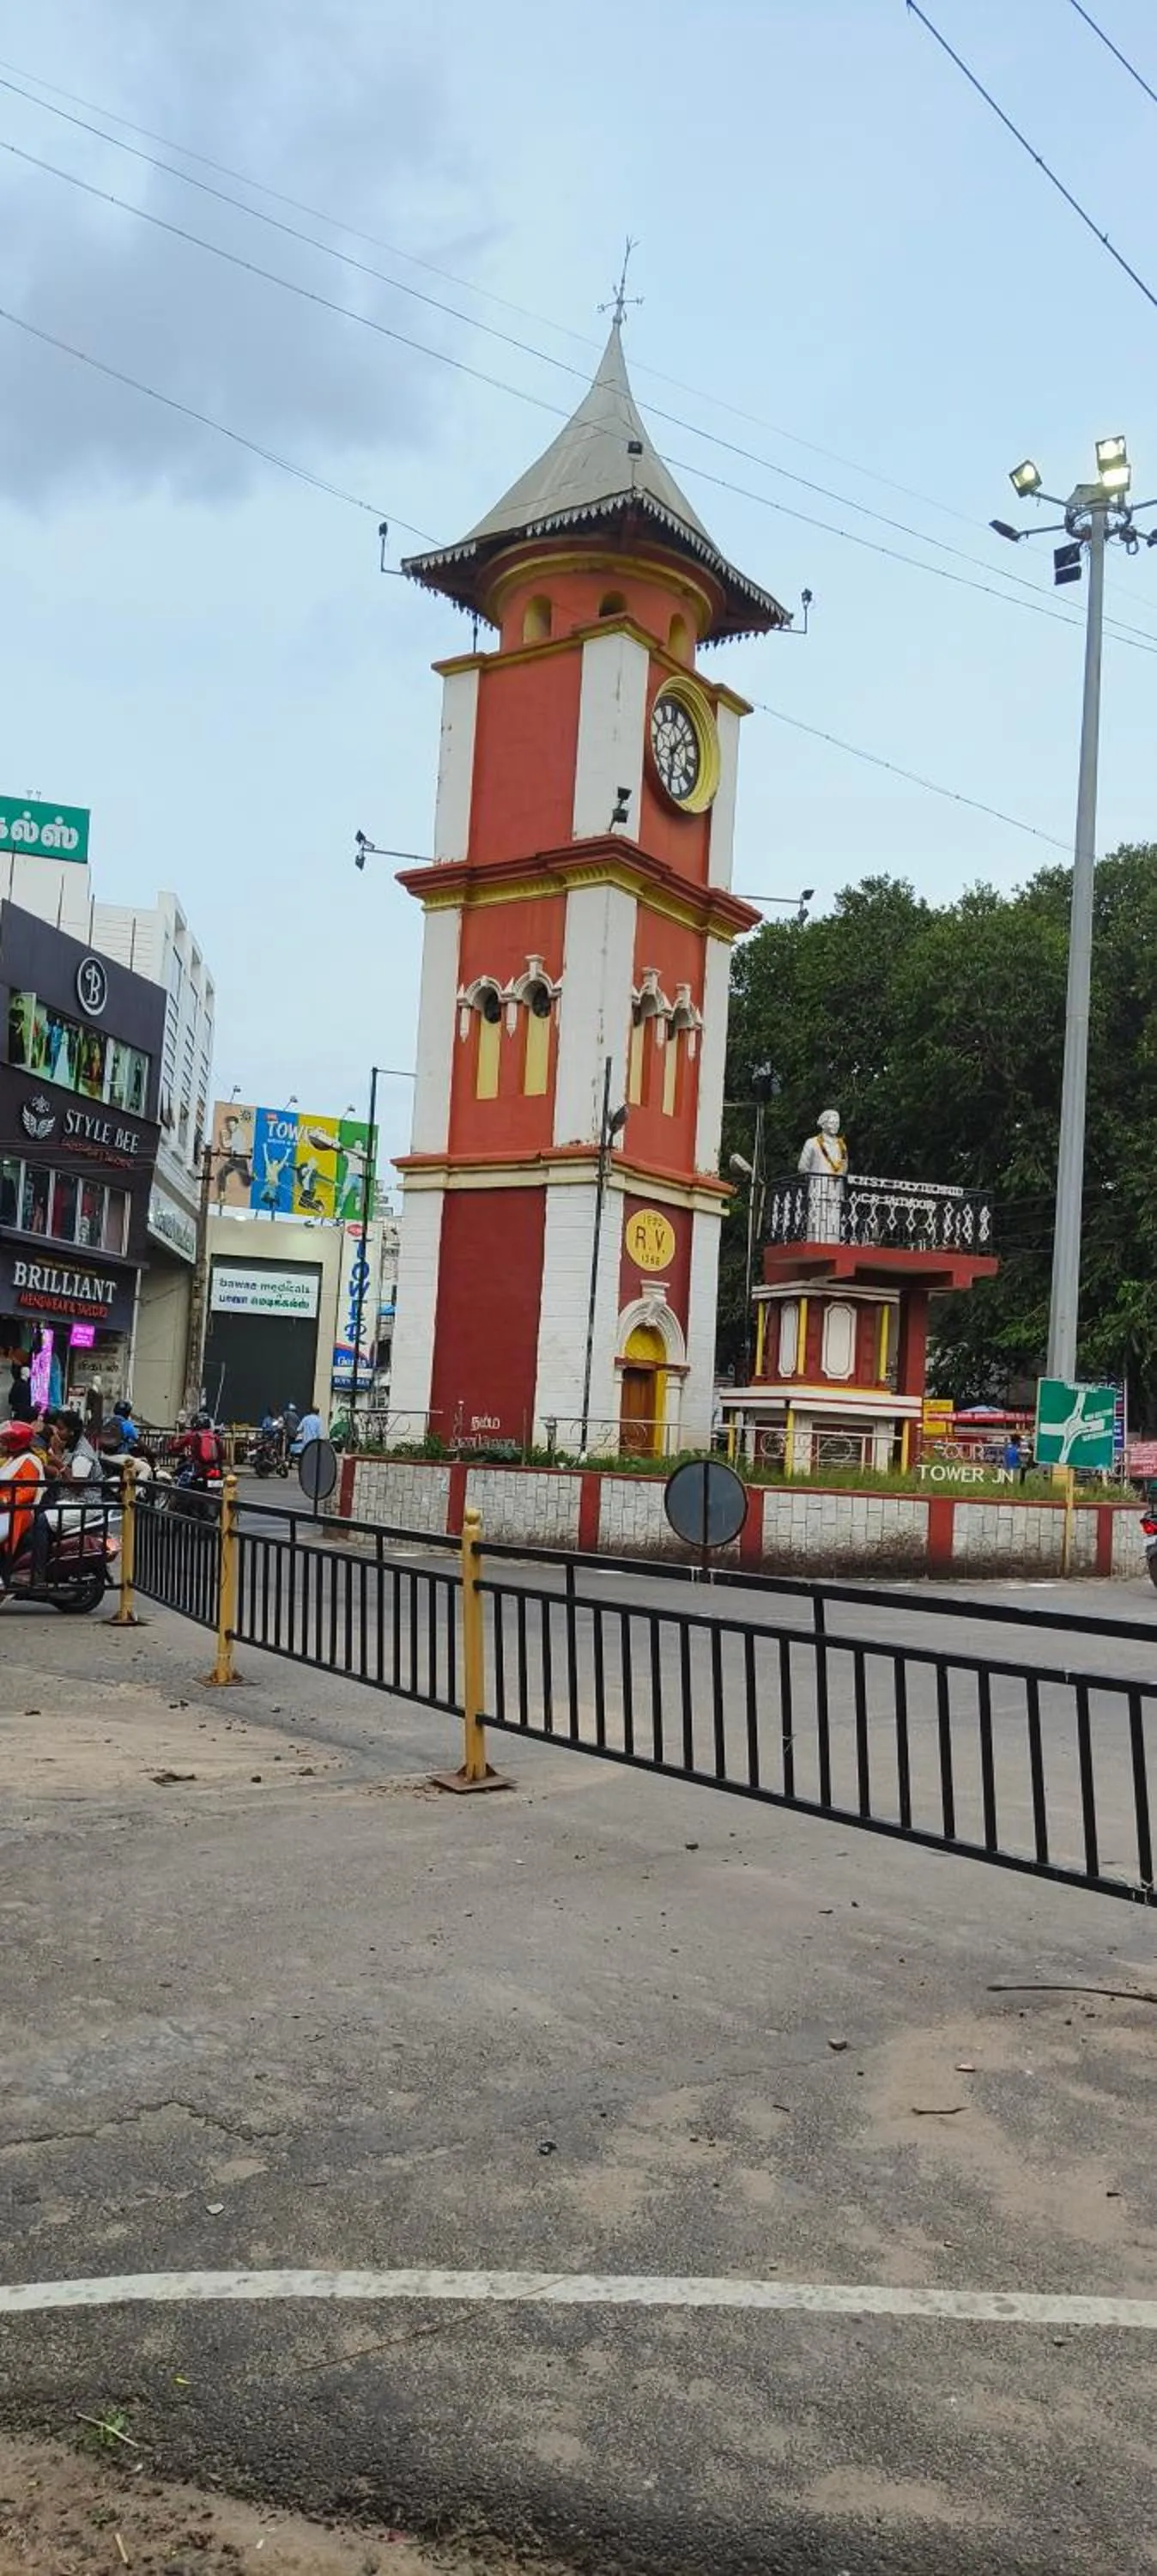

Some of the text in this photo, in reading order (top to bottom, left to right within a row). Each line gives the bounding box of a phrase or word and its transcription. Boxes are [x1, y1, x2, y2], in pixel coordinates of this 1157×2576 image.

[64, 1109, 112, 1145] STYLE
[114, 1127, 140, 1154] BEE
[13, 1261, 118, 1303] BRILLIANT
[260, 1280, 310, 1294] medicals
[344, 1239, 372, 1346] TOWER
[916, 1464, 1014, 1484] TOWER JN
